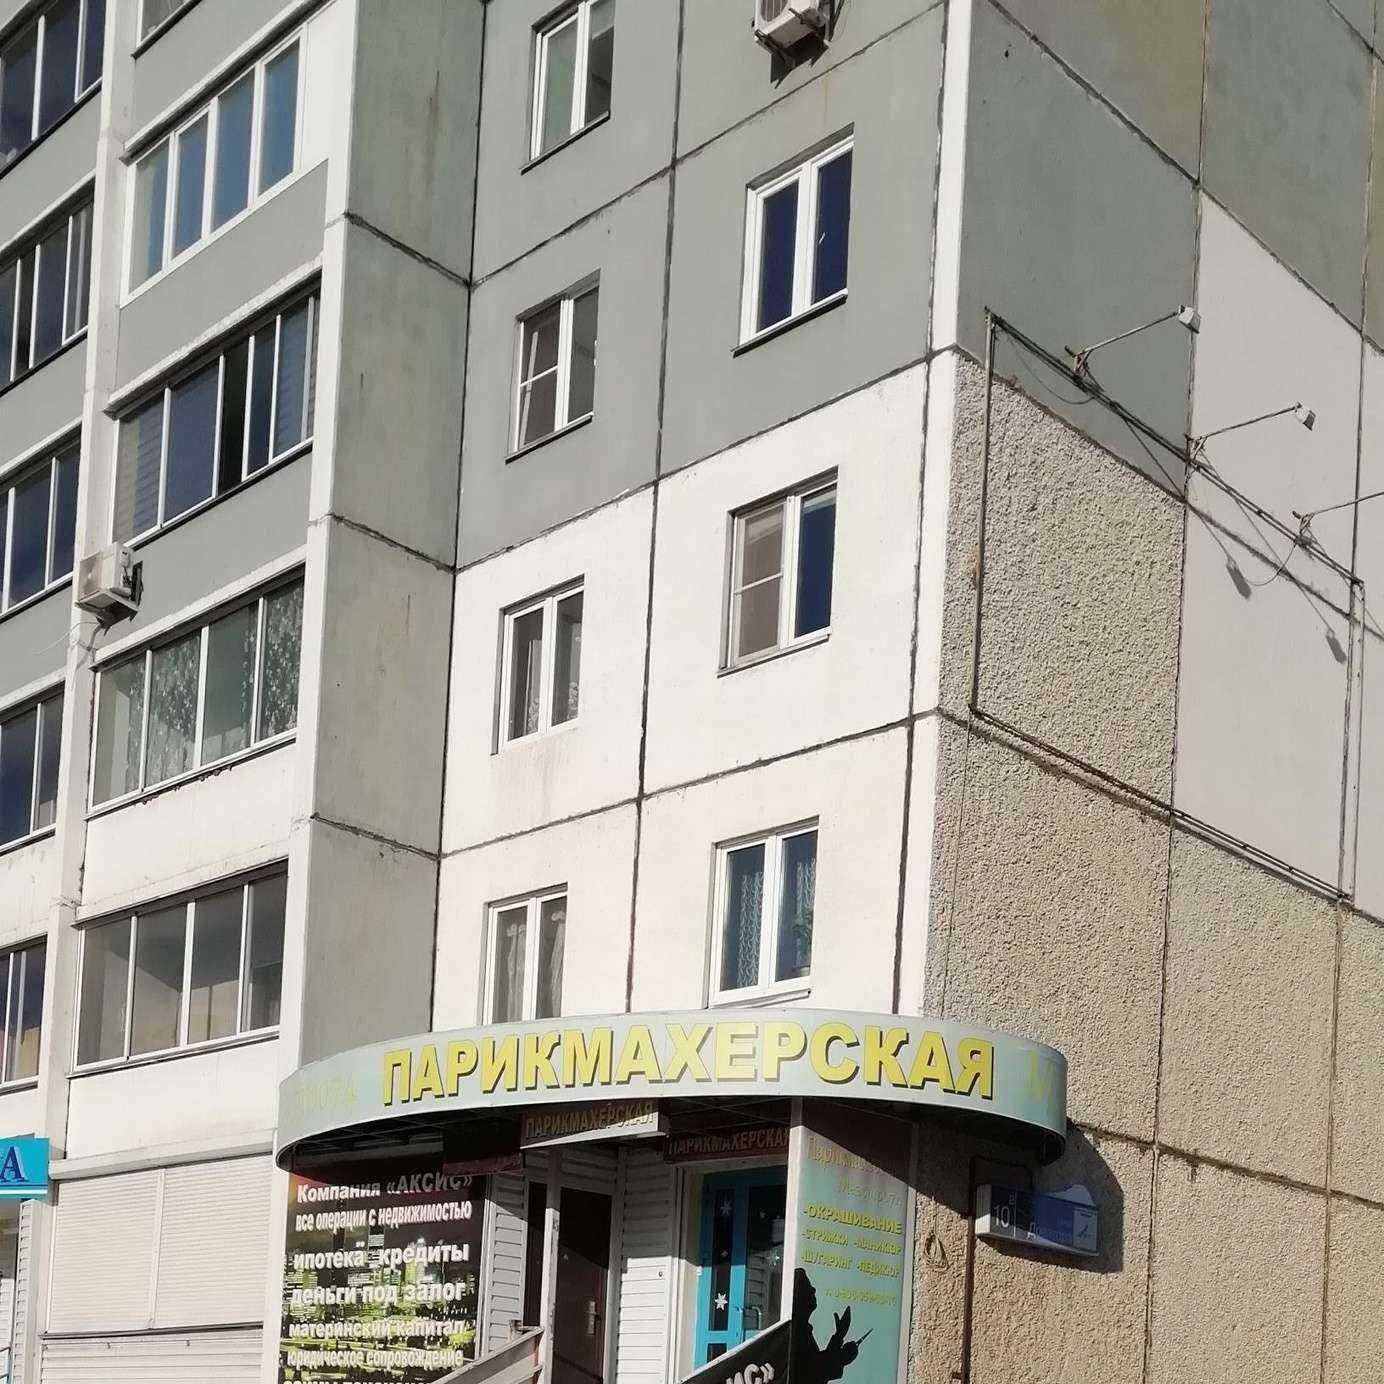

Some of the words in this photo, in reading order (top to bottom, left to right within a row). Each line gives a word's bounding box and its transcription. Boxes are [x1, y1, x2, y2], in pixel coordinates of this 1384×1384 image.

[383, 1020, 995, 1106] ПАРИКМАХЕРСКАЯ
[525, 1102, 654, 1139] ПАРИКМАХЕРСКАЯ
[297, 1181, 381, 1204] Компания
[387, 1171, 473, 1195] «АКСИС»
[295, 1213, 315, 1232] все
[316, 1209, 367, 1234] операции
[368, 1207, 378, 1226] с
[378, 1200, 473, 1229] недвижимостью
[993, 1204, 1010, 1228] 10
[293, 1250, 366, 1270] ипотека
[379, 1244, 470, 1270] кредиты
[291, 1285, 357, 1306] деньги
[362, 1284, 398, 1307] под
[405, 1281, 467, 1302] залог
[288, 1318, 392, 1339] материнский
[399, 1318, 466, 1337] капитал
[286, 1349, 365, 1371] юридическое
[366, 1349, 464, 1372] сопровождение
